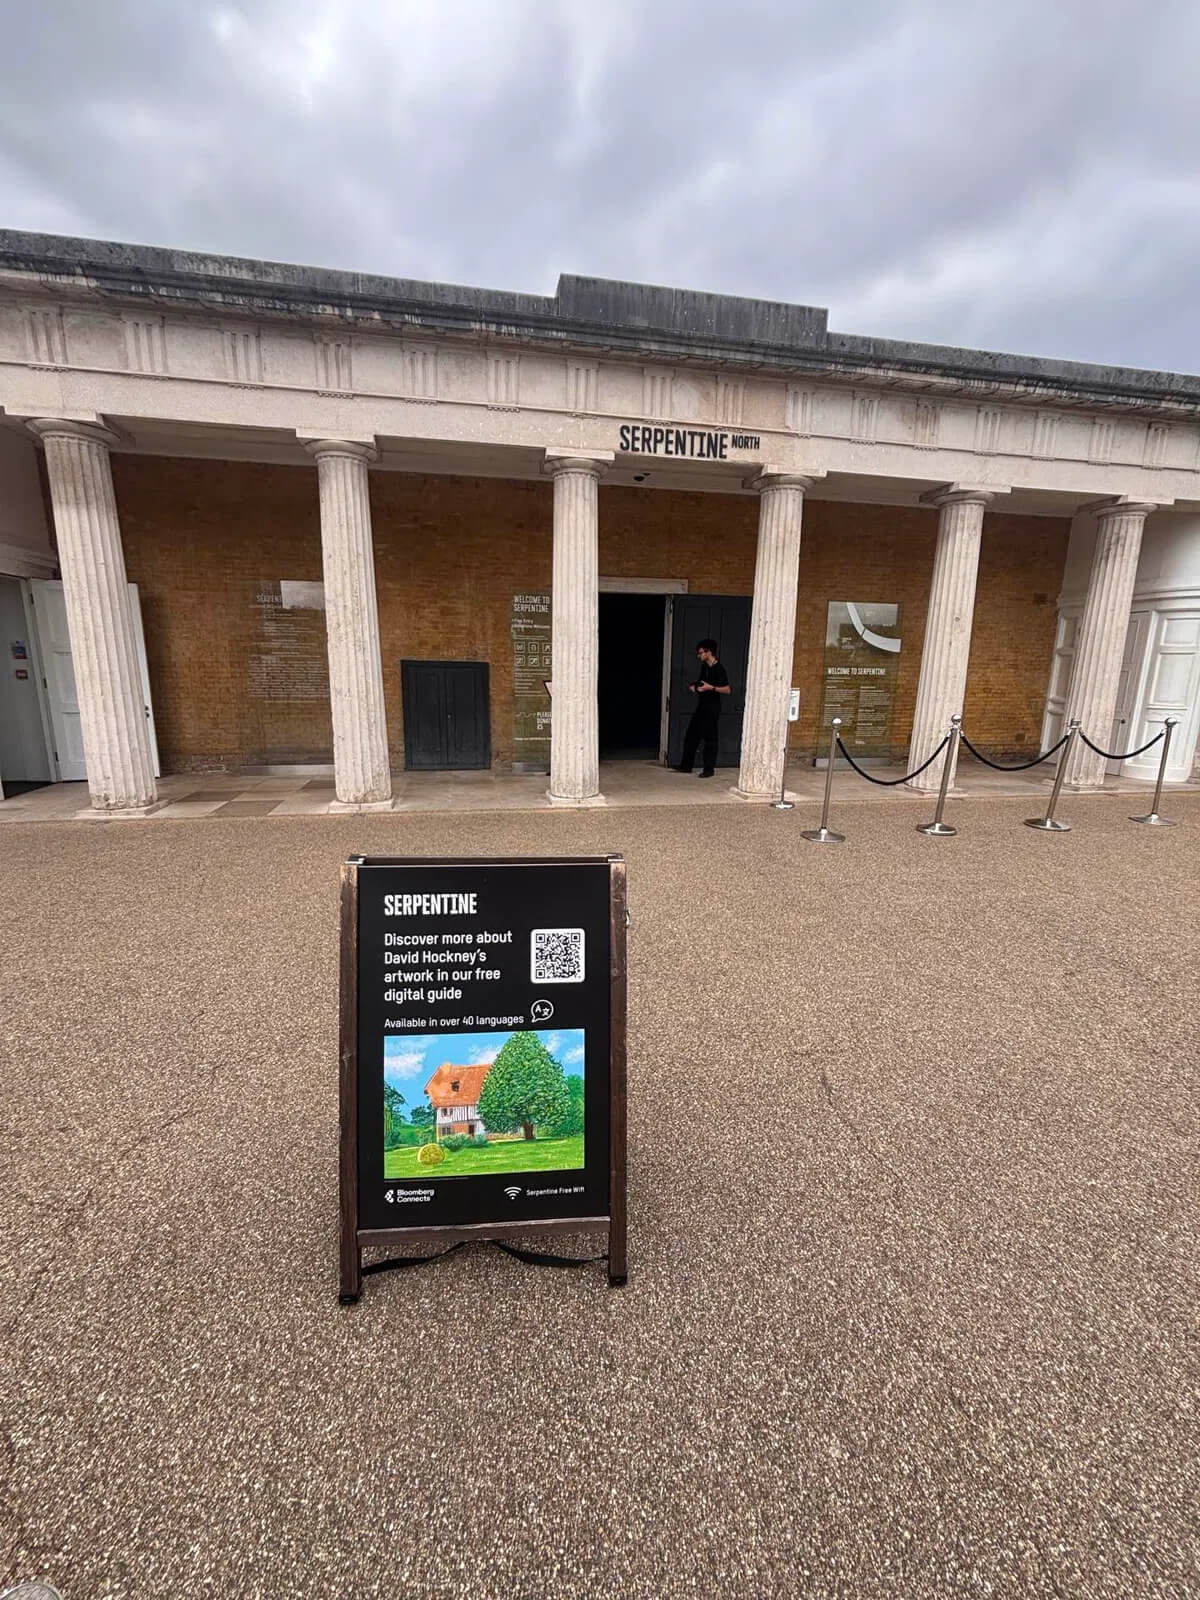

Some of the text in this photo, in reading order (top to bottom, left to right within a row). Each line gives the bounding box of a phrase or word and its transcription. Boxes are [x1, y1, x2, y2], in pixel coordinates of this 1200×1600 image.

[619, 425, 761, 459] SERPENTINE NORTH
[513, 594, 550, 605] WELCOME TO
[513, 603, 549, 613] SERPENTINE
[828, 667, 886, 676] WELCOME TO SERPENTINE
[384, 893, 478, 916] SERPENTINE
[384, 930, 512, 946] Discover more about
[384, 949, 487, 965] David Hockney’s
[384, 967, 501, 983] artwork in our free
[384, 986, 462, 1005] digital guide
[384, 1014, 524, 1029] Available in over 40 languages
[397, 1189, 435, 1197] Bloomberg
[526, 1188, 558, 1197] Serpentine
